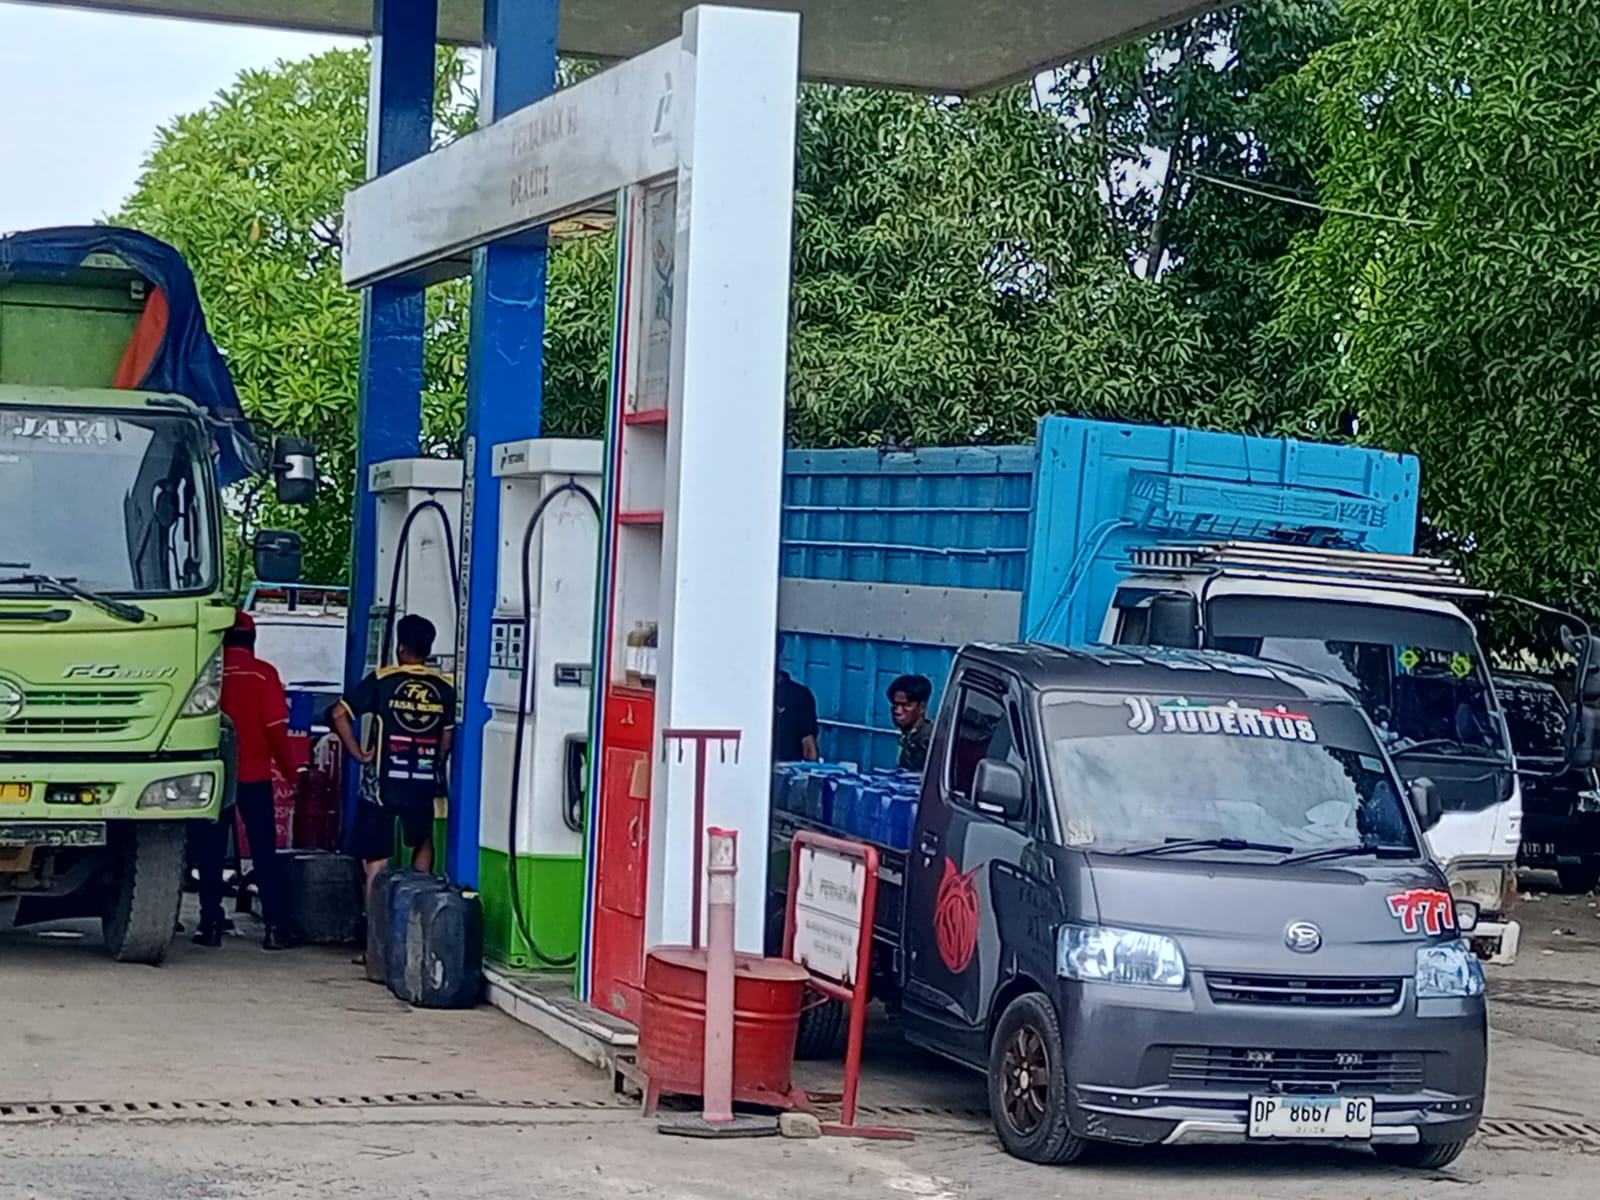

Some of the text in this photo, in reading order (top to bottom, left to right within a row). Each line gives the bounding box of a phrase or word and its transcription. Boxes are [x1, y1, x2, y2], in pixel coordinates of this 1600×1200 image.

[13, 417, 107, 437] JAYA
[1158, 706, 1317, 742] JUVENTUS
[1386, 889, 1455, 936] 777
[1255, 1101, 1367, 1122] DP 8667 BC
